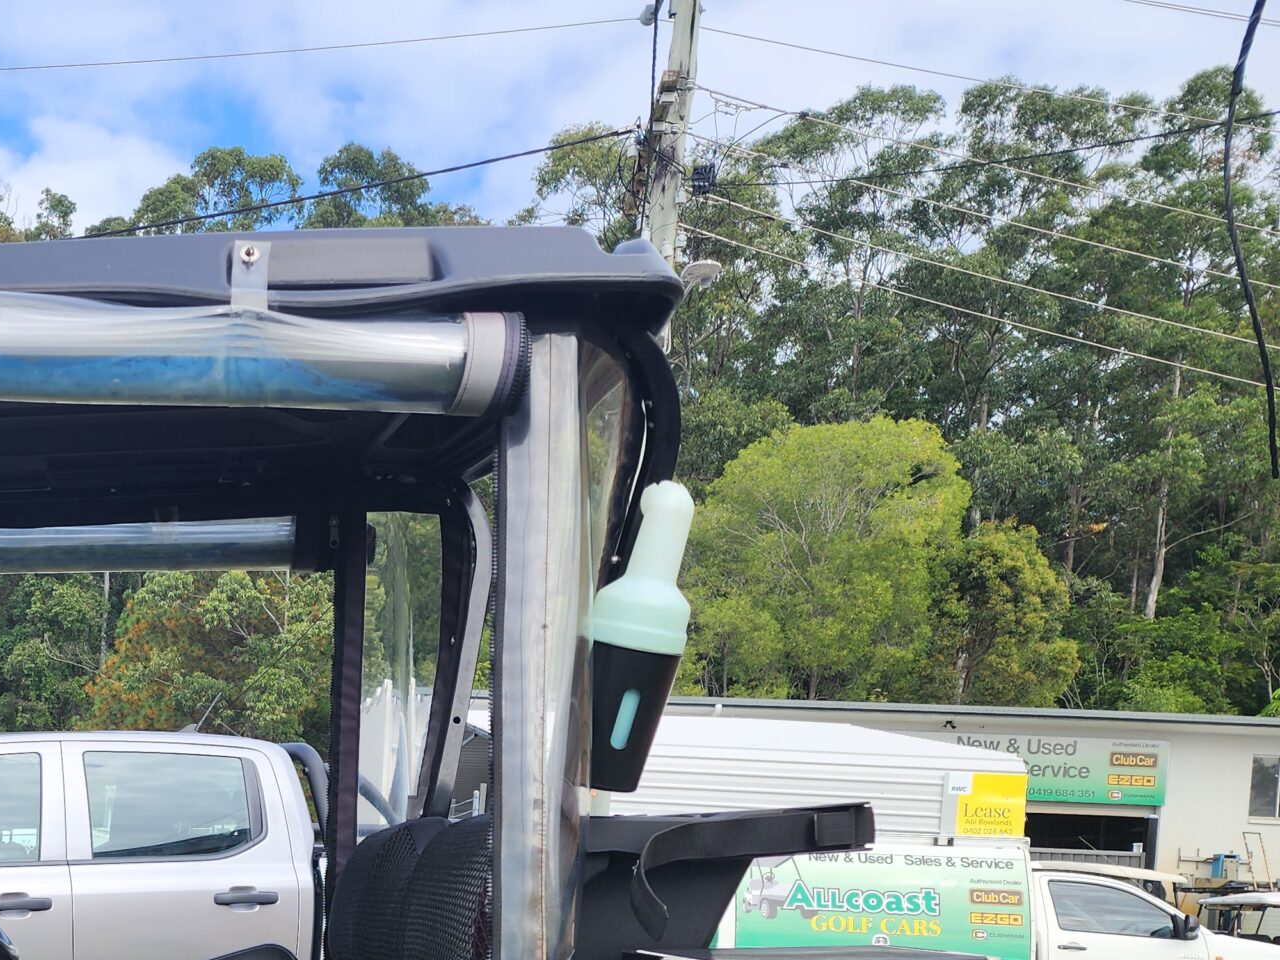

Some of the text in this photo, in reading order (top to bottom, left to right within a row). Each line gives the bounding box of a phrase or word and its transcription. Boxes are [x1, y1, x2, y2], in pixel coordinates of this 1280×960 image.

[957, 736, 1077, 756] New & Used
[1113, 754, 1155, 766] Club Car
[1028, 787, 1095, 798] 0419 684 351
[963, 802, 1011, 818] Lease
[978, 818, 1012, 826] Rowlands
[808, 852, 1014, 870] New & Used Sales & Service
[973, 892, 1019, 903] Club Car
[810, 914, 942, 937] GOLF CARS
